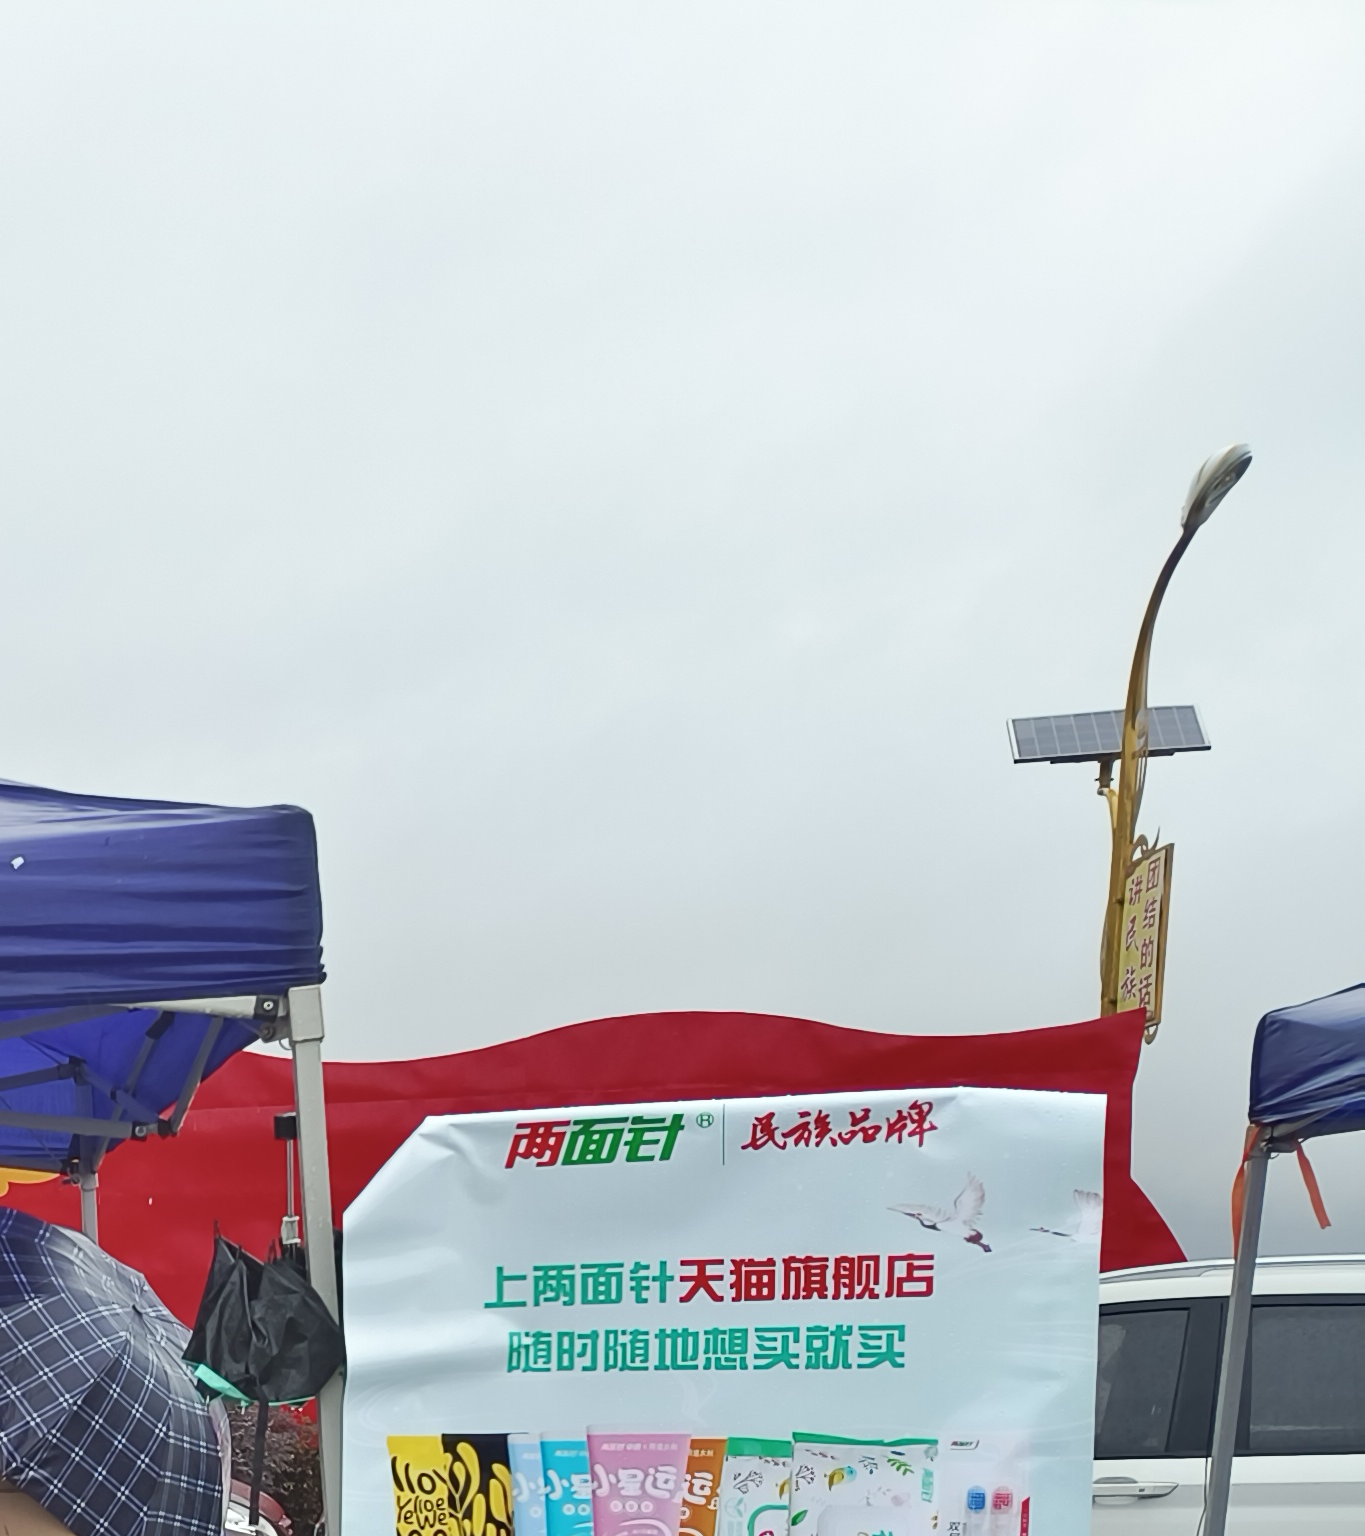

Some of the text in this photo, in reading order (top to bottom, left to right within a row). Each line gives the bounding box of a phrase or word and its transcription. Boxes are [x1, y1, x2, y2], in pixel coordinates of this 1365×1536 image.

[1121, 875, 1142, 1001] 讲民族
[505, 1101, 939, 1169] 两面针 民族品牌
[483, 1252, 936, 1310] 上两面针天猫旗舰店
[507, 1323, 906, 1374] 随时随地想买就买
